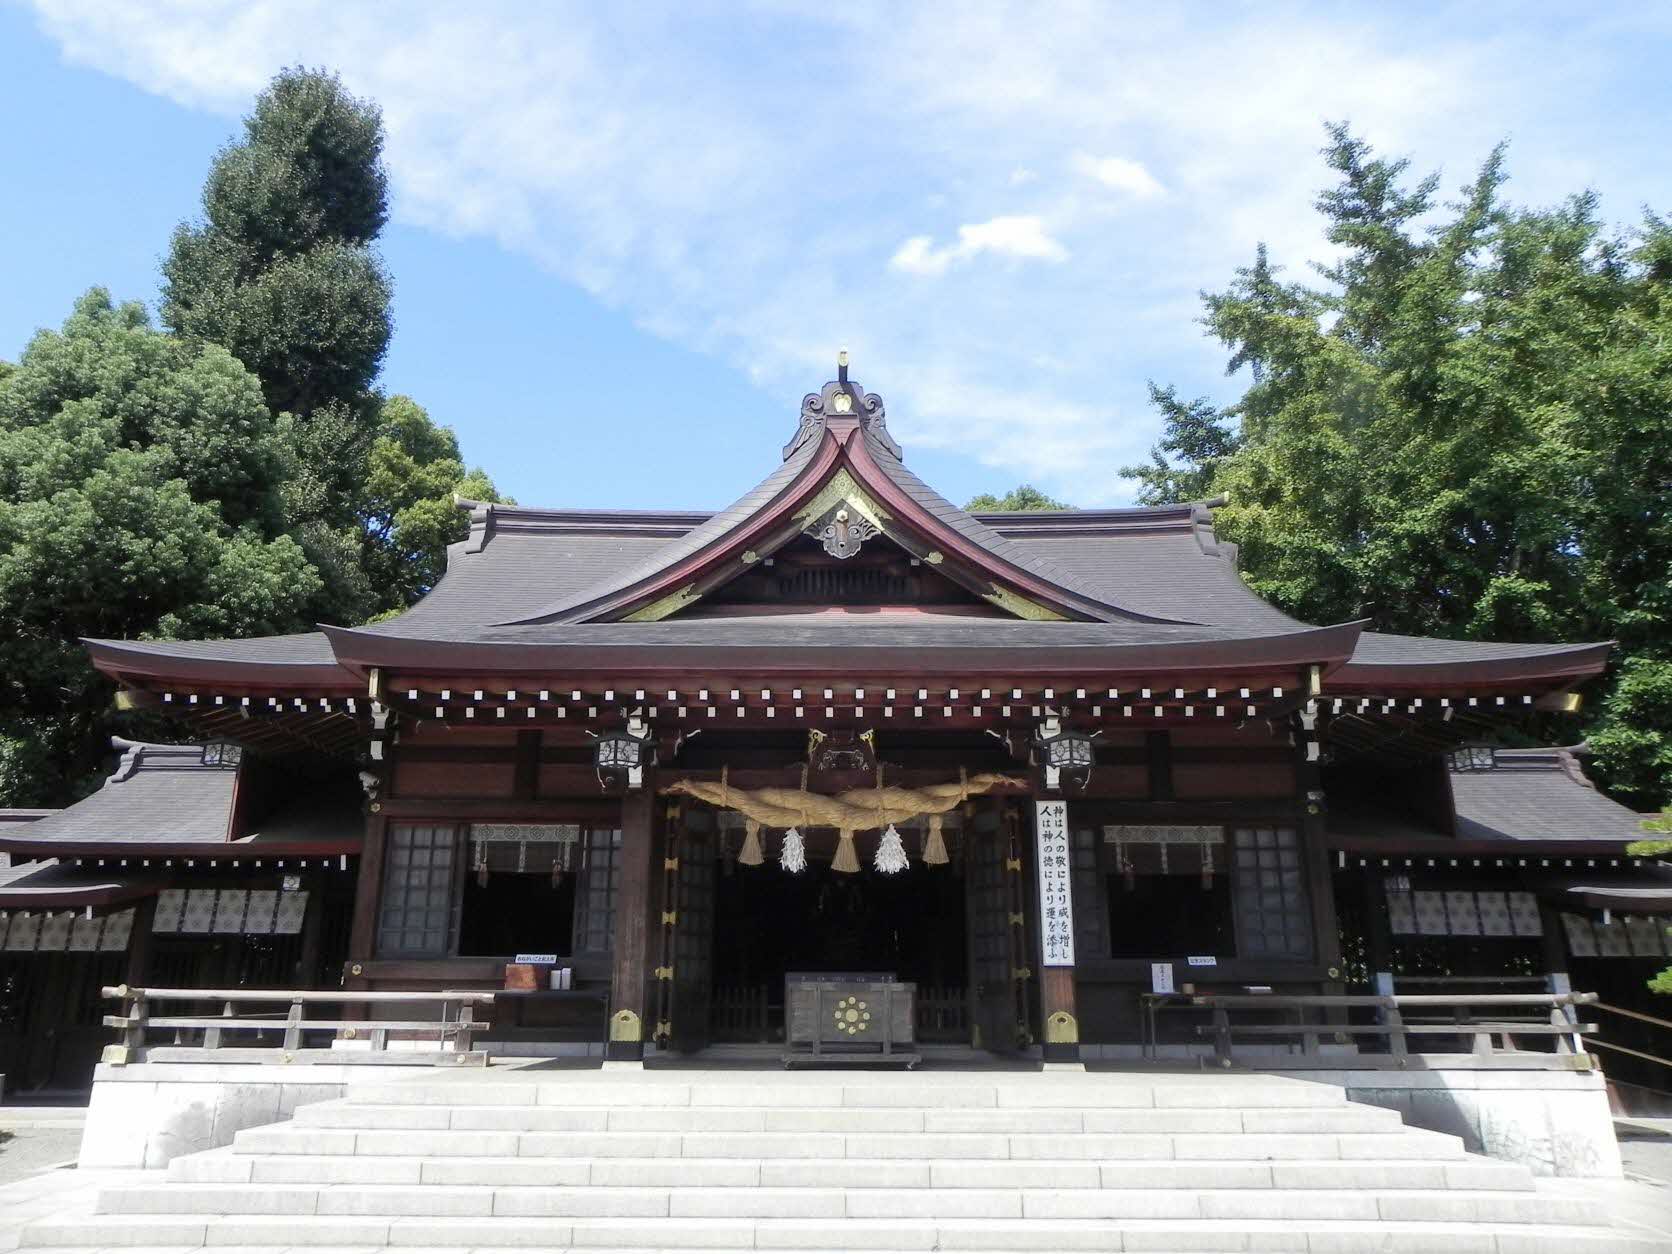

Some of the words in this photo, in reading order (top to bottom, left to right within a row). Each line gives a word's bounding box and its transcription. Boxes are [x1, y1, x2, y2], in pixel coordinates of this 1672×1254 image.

[1040, 805, 1058, 960] 人は神の徳により運を添ふ
[1053, 805, 1070, 959] 神は人の敬により威を増し
